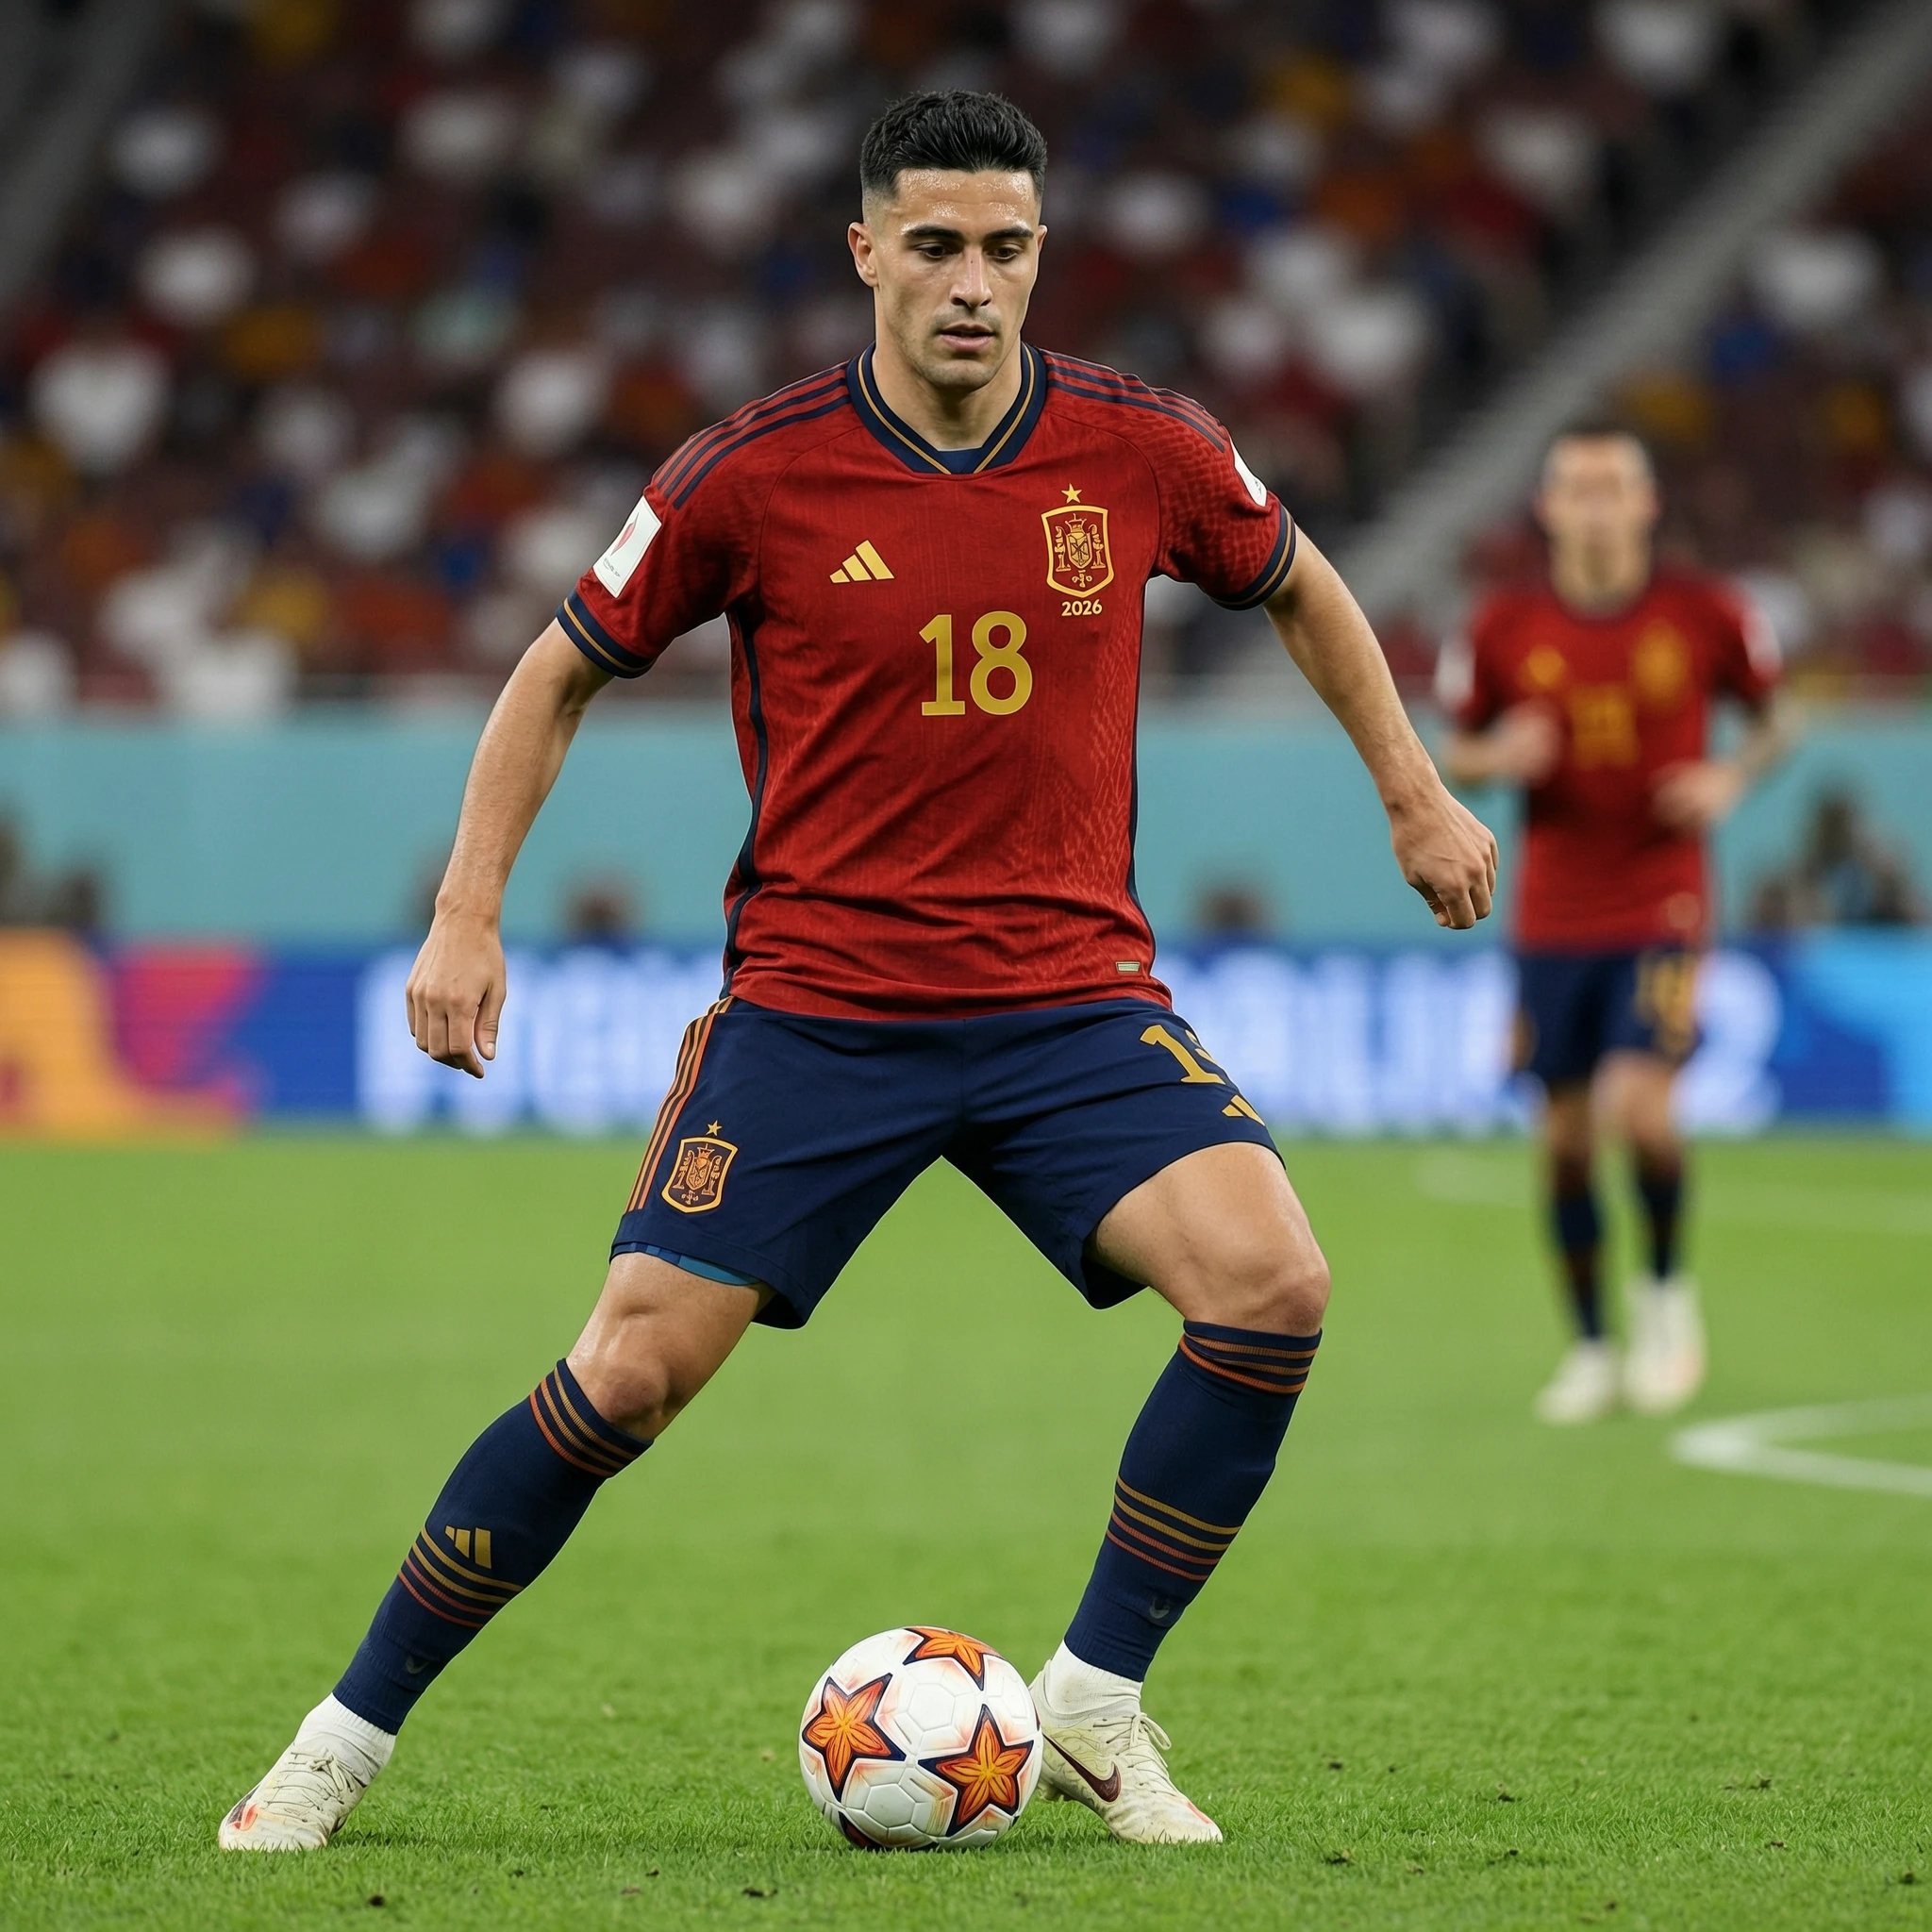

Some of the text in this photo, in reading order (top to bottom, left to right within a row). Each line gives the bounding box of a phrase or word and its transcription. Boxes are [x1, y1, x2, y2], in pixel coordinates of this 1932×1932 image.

[1061, 599, 1103, 616] 2026
[919, 610, 1033, 716] 18
[1140, 1024, 1226, 1085] 1
